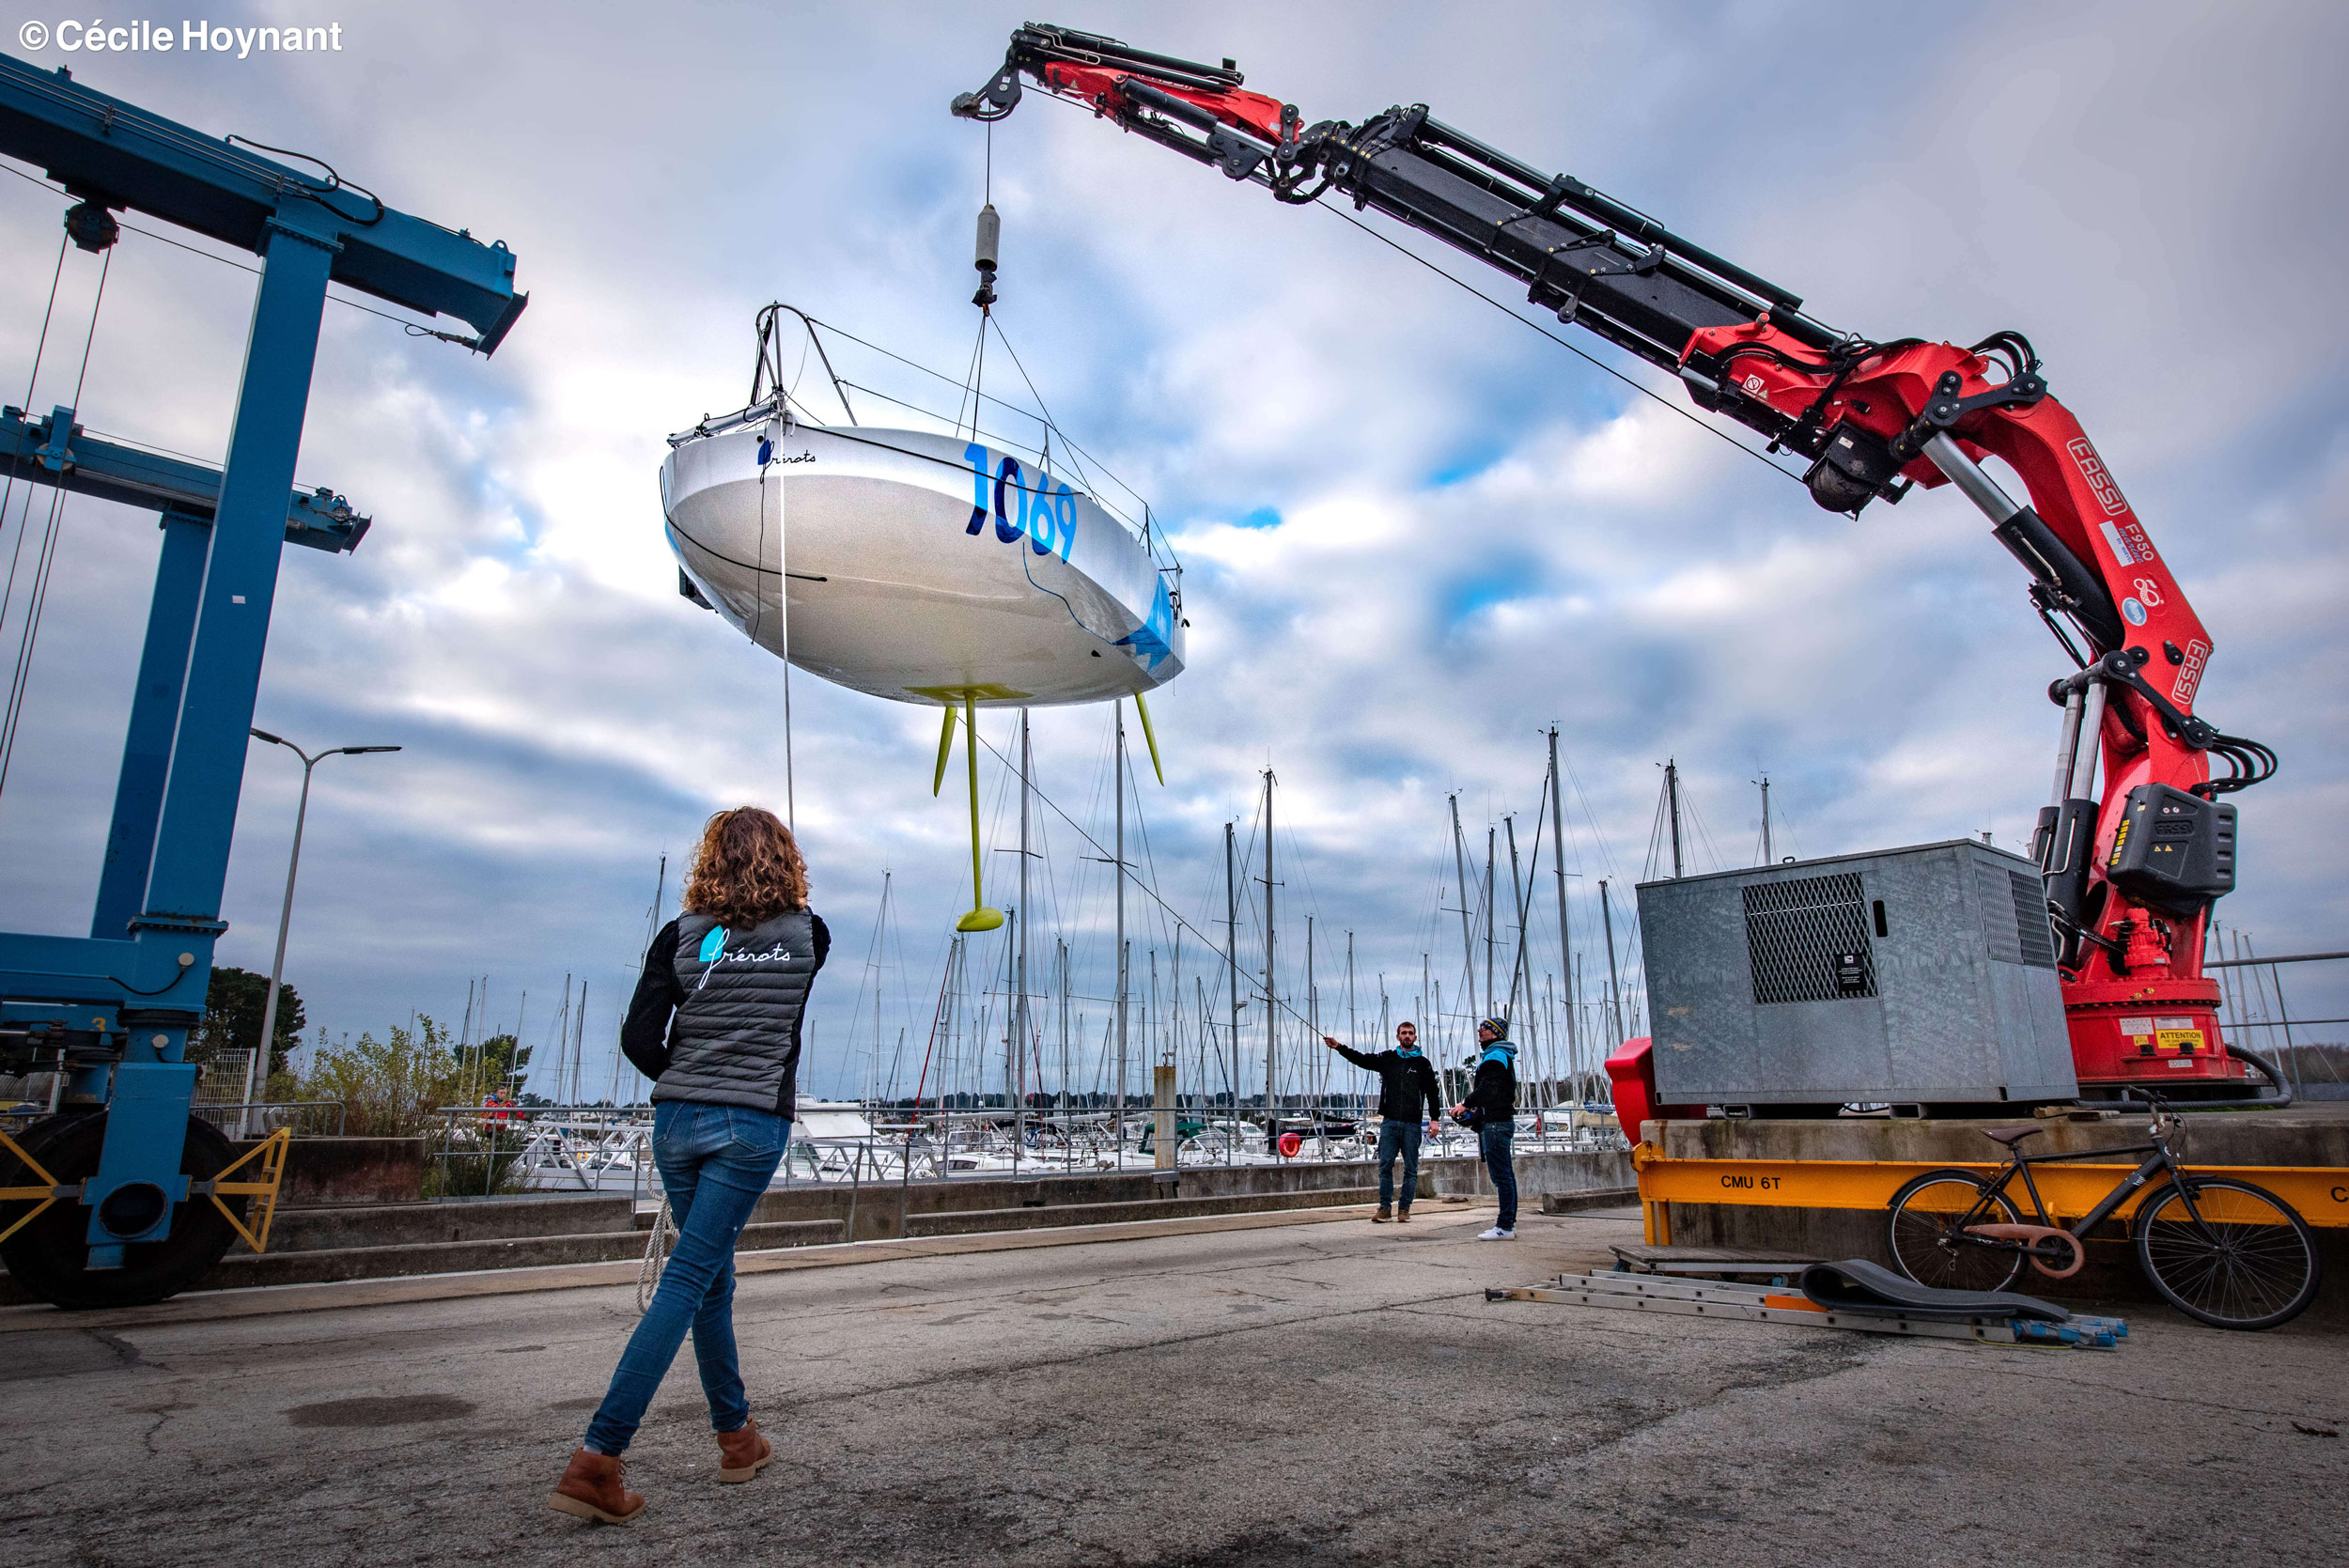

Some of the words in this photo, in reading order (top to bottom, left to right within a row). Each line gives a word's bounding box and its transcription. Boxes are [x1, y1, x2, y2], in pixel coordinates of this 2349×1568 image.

[2072, 442, 2123, 513] FASSI
[964, 442, 1077, 565] 1069
[2119, 527, 2144, 564] marine
[2125, 523, 2155, 561] F950
[2175, 644, 2205, 702] FASSI
[1720, 1175, 1753, 1188] CMU
[1761, 1177, 1781, 1189] 6T
